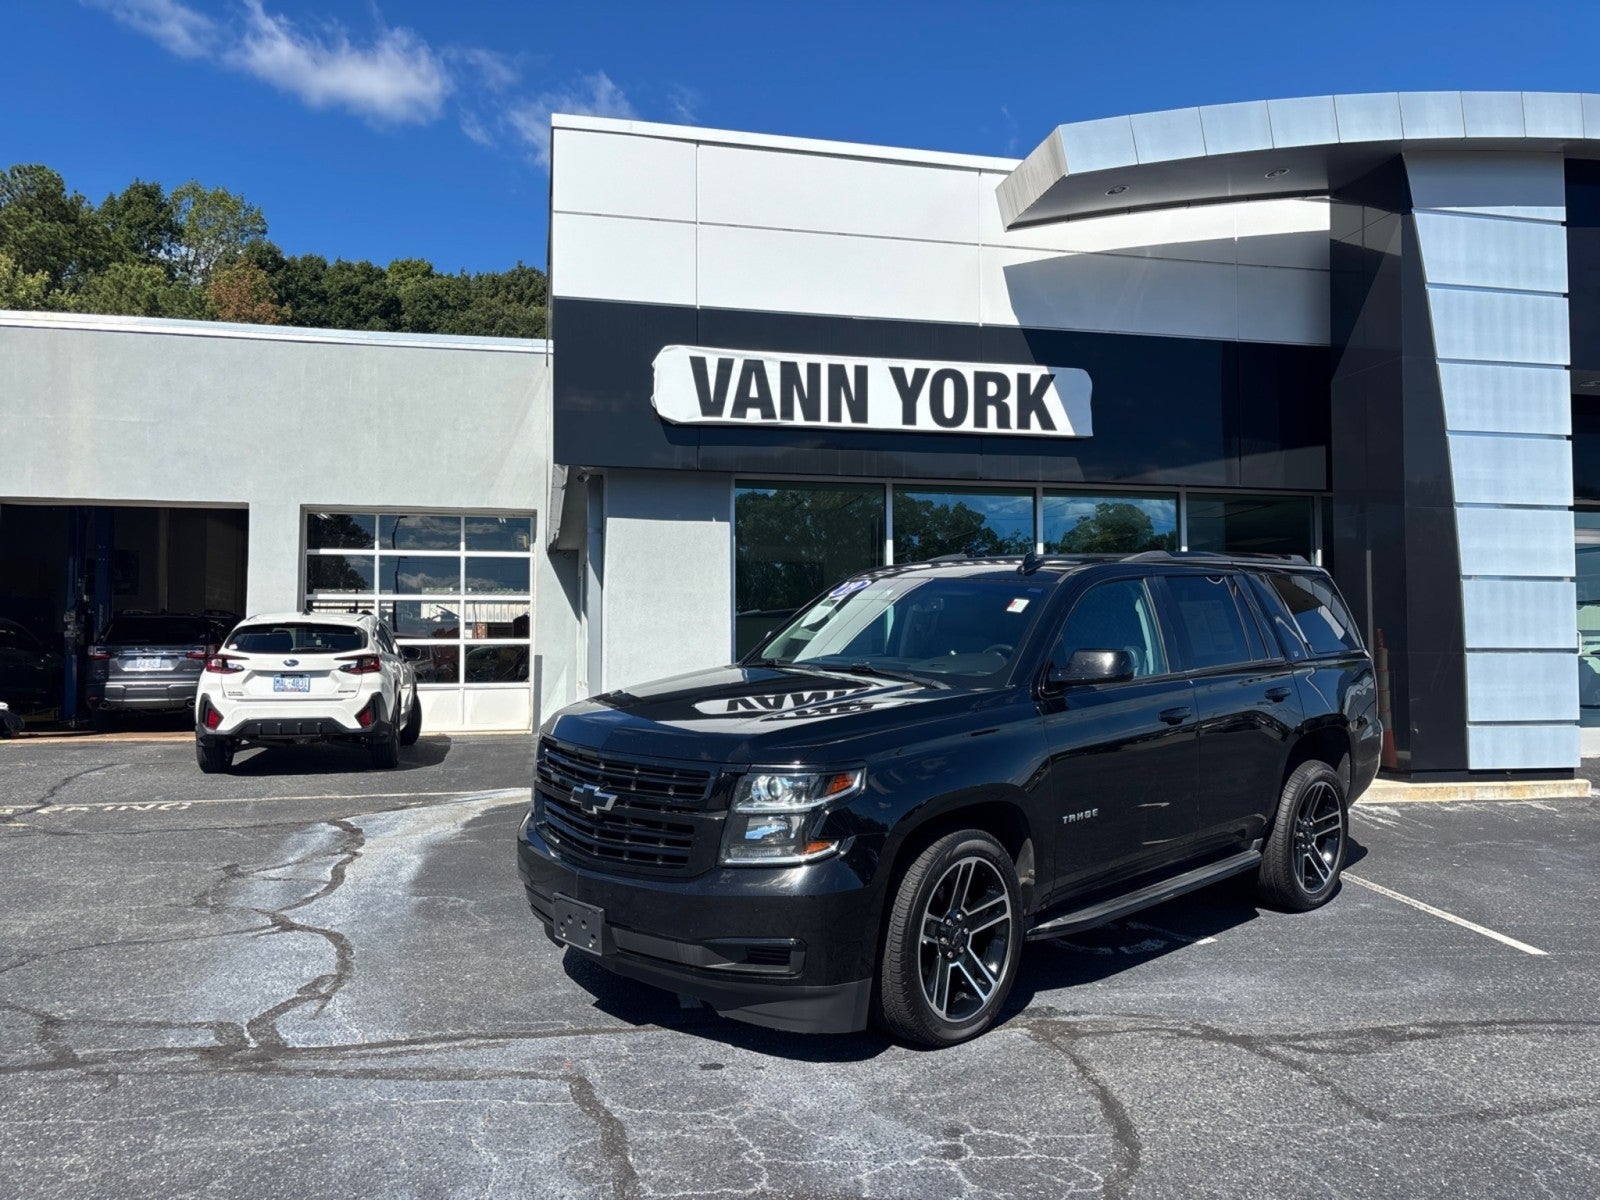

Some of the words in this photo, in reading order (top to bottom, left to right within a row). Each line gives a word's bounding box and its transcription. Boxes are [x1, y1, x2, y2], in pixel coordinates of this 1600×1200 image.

[689, 355, 869, 424] VANN
[888, 366, 1058, 431] YORK
[1062, 808, 1099, 824] TAHOE
